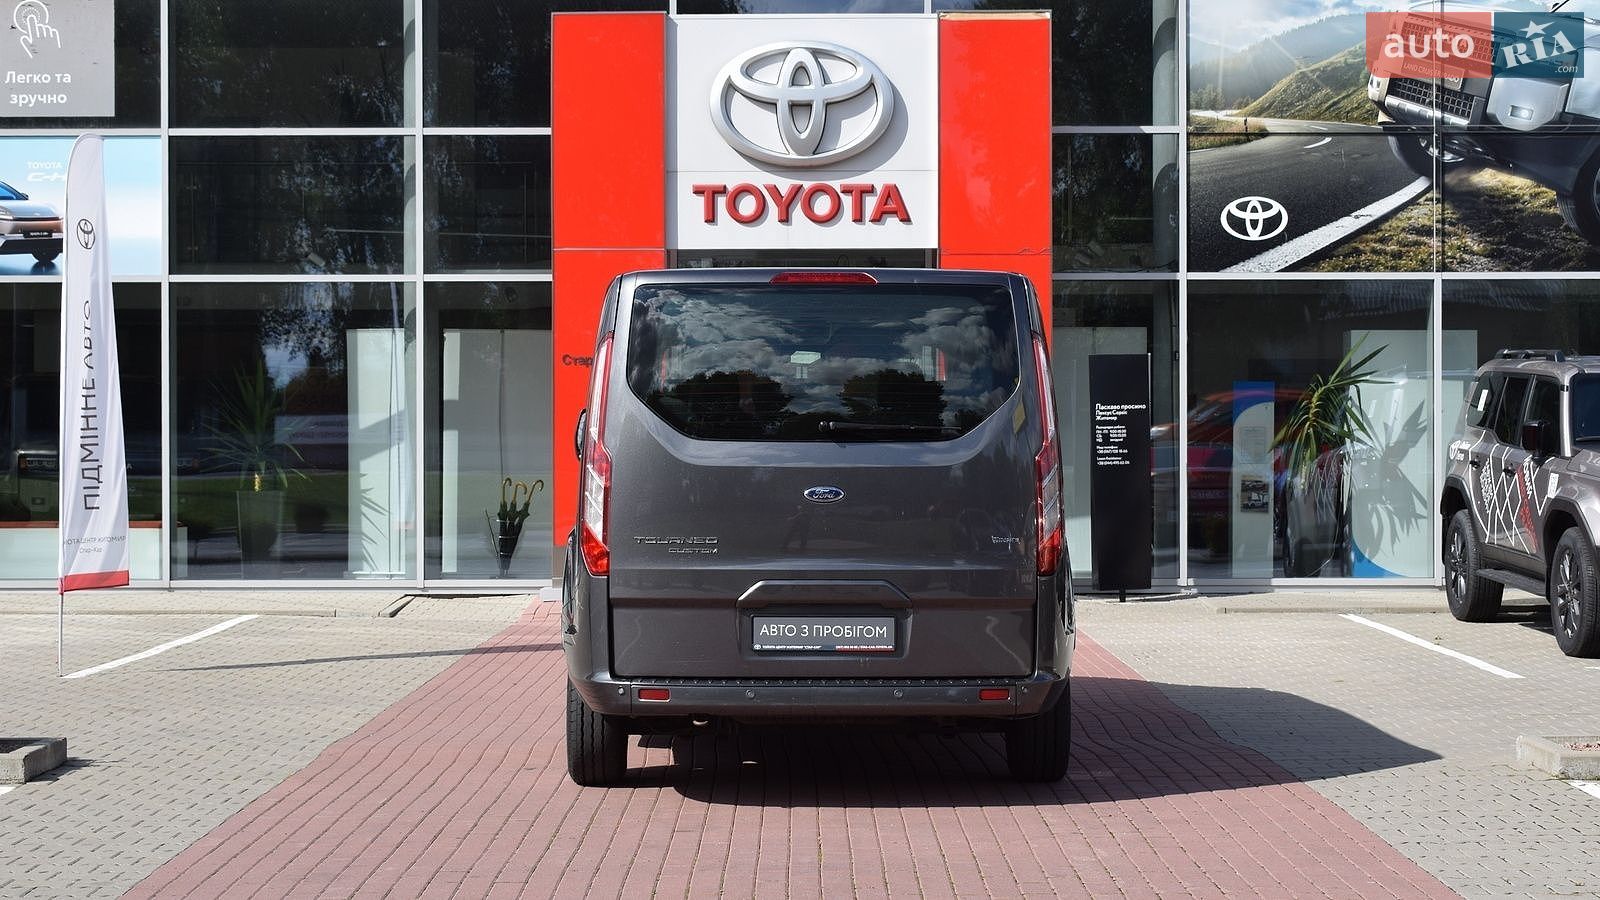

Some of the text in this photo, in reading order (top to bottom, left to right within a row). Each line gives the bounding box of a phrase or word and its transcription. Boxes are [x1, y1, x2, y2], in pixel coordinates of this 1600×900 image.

[4, 71, 72, 84] Легко та
[9, 93, 68, 108] зручно
[27, 161, 63, 169] TOYOTA
[692, 182, 913, 225] TOYOTA
[80, 378, 103, 510] ПІДМІННЕ
[812, 489, 836, 499] Ford
[633, 536, 719, 545] TOURNEO
[760, 624, 888, 639] АВТО З ПРОБІГОМ
